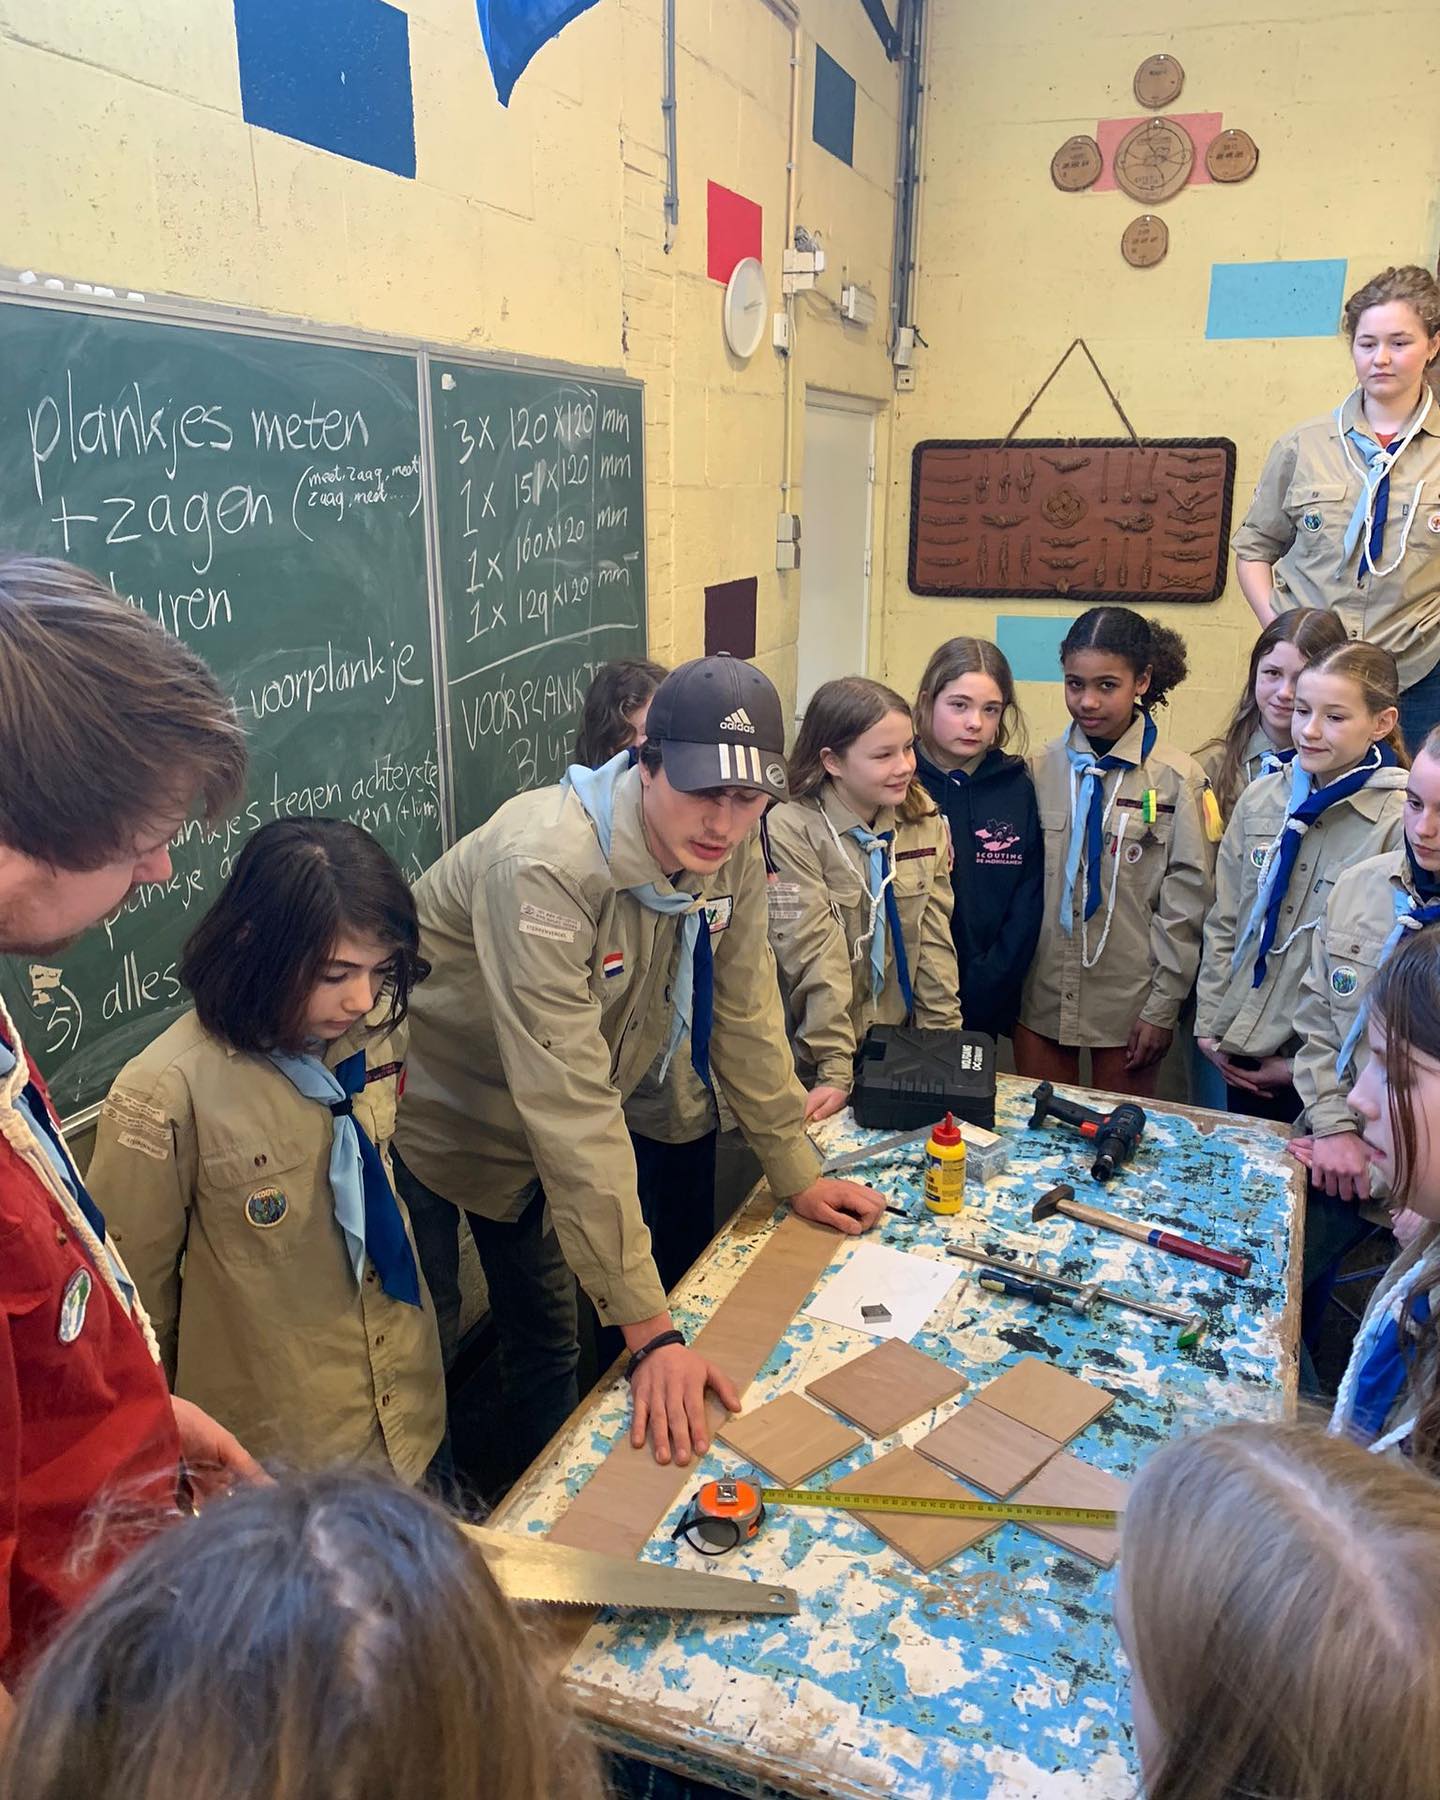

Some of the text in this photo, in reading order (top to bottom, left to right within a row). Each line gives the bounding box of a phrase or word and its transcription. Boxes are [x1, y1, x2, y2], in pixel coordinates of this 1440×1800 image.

[27, 369, 369, 505] plankjes meten
[601, 404, 630, 443] mm
[600, 453, 631, 480] mm
[597, 506, 629, 530] mm
[598, 565, 630, 588] mm
[250, 636, 424, 719] voorplankje
[719, 720, 756, 734] adidas
[270, 772, 342, 819] tegen
[351, 749, 439, 800] achterste
[975, 851, 1023, 860] SCOUTING
[102, 950, 182, 1020] alles
